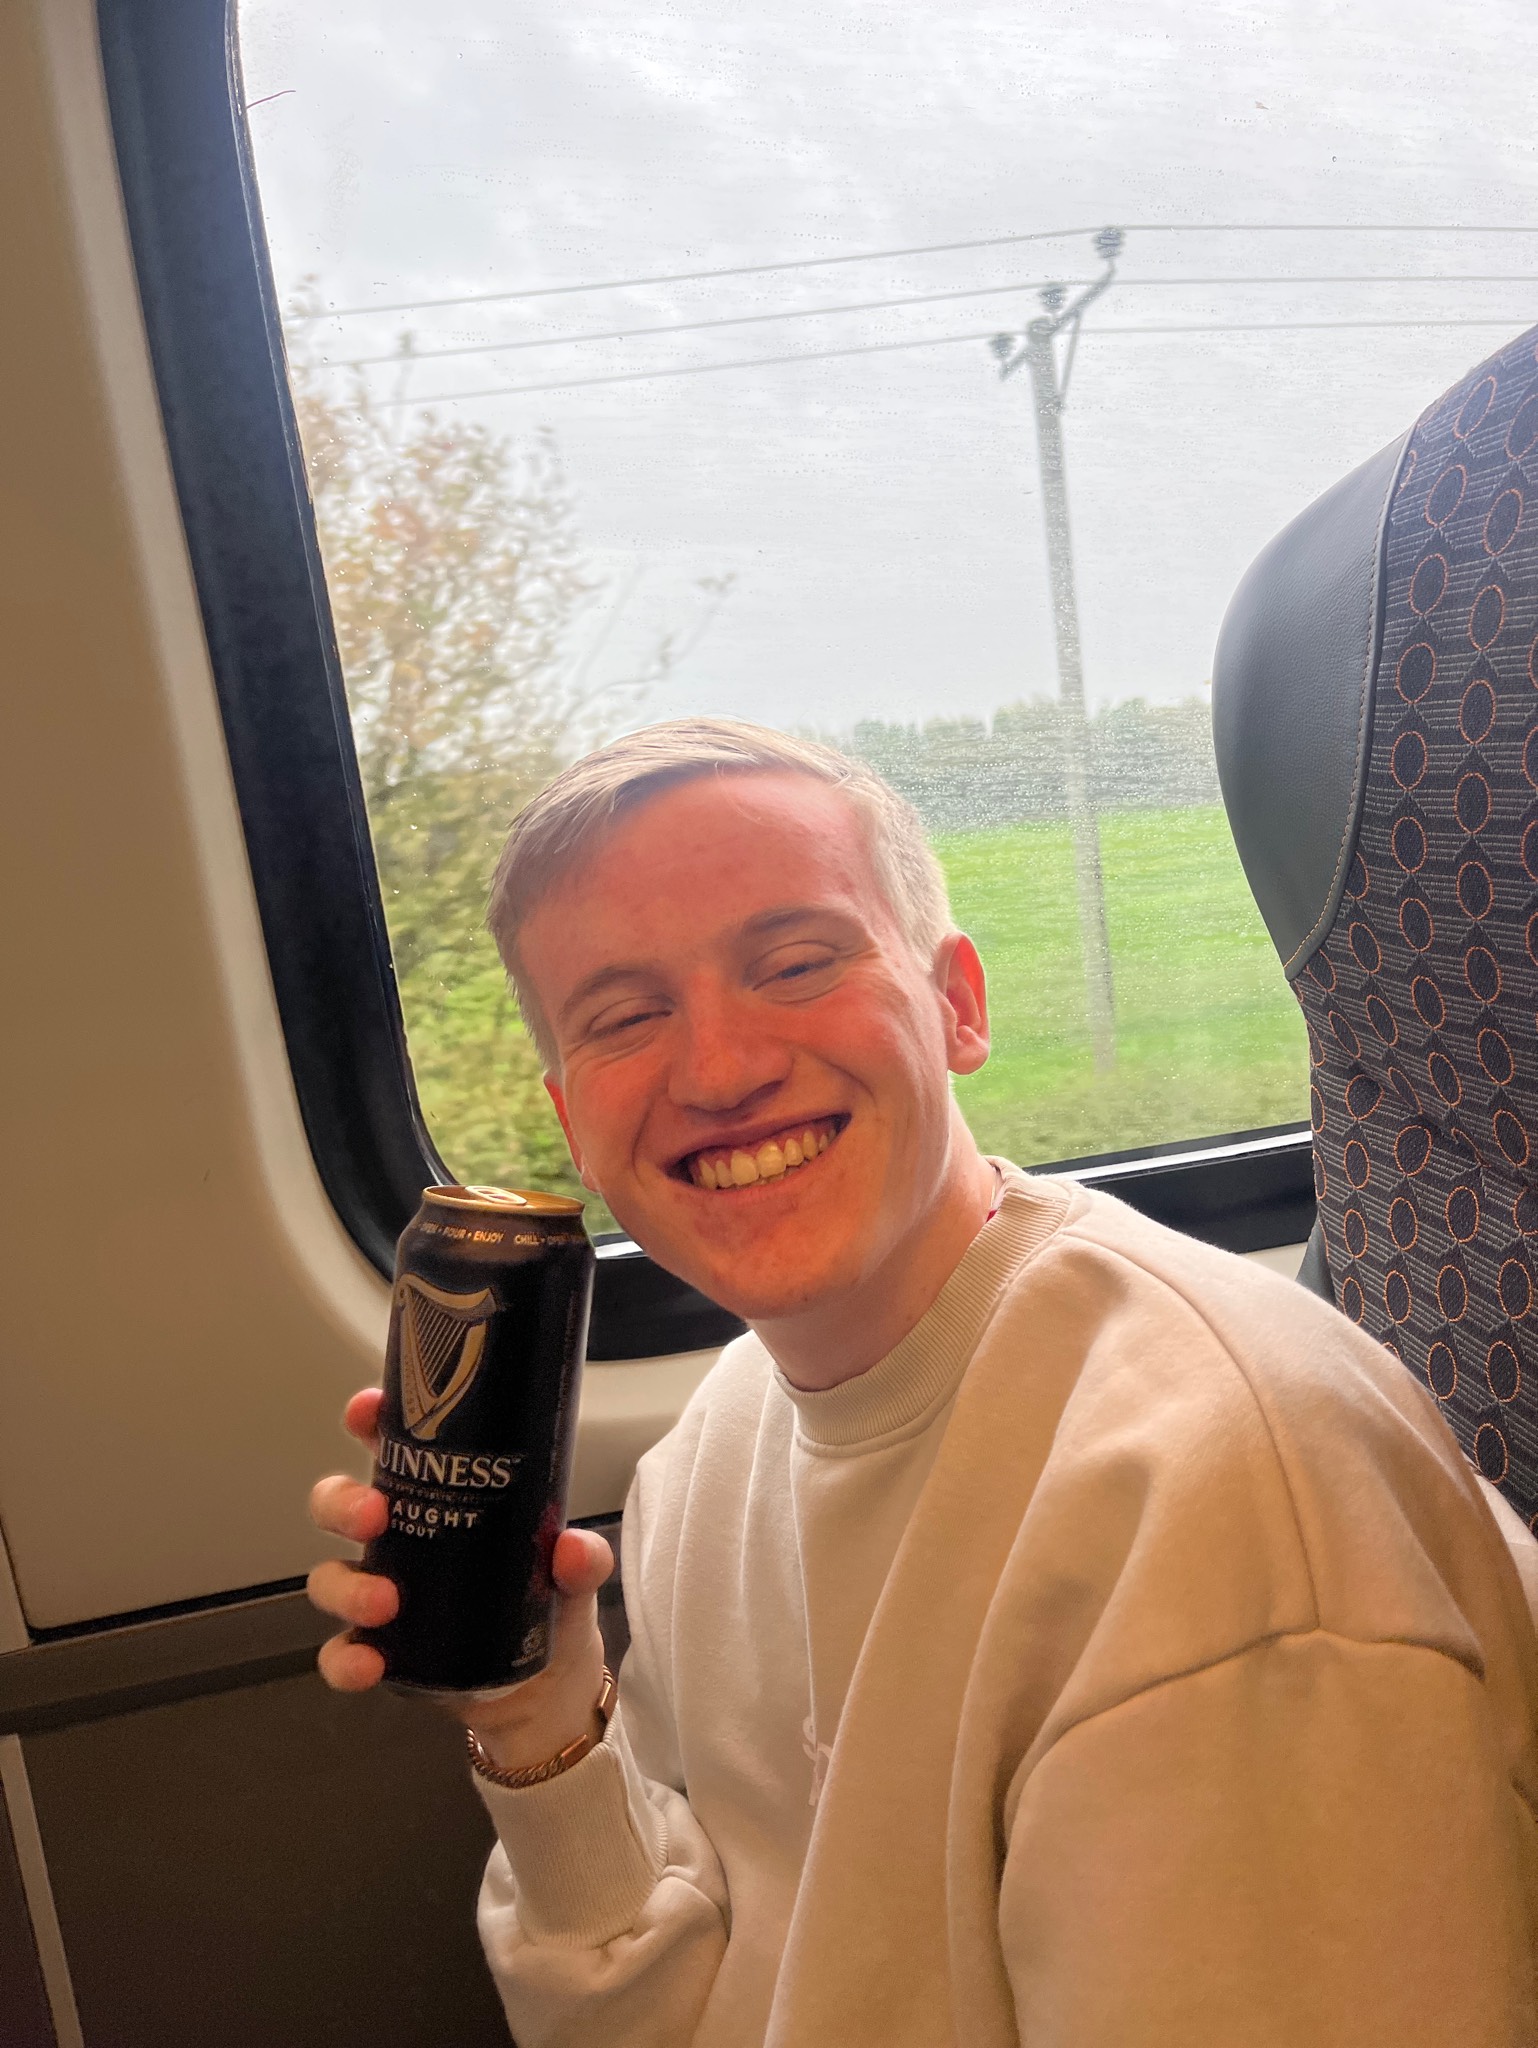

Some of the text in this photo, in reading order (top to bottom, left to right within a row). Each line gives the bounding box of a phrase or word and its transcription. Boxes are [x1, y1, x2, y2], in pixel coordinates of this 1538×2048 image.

[473, 1230, 504, 1244] ENJOY
[514, 1234, 540, 1246] CHILL
[378, 1435, 511, 1489] UINNESS
[392, 1499, 478, 1529] AUGHT
[391, 1517, 437, 1539] STOUT
